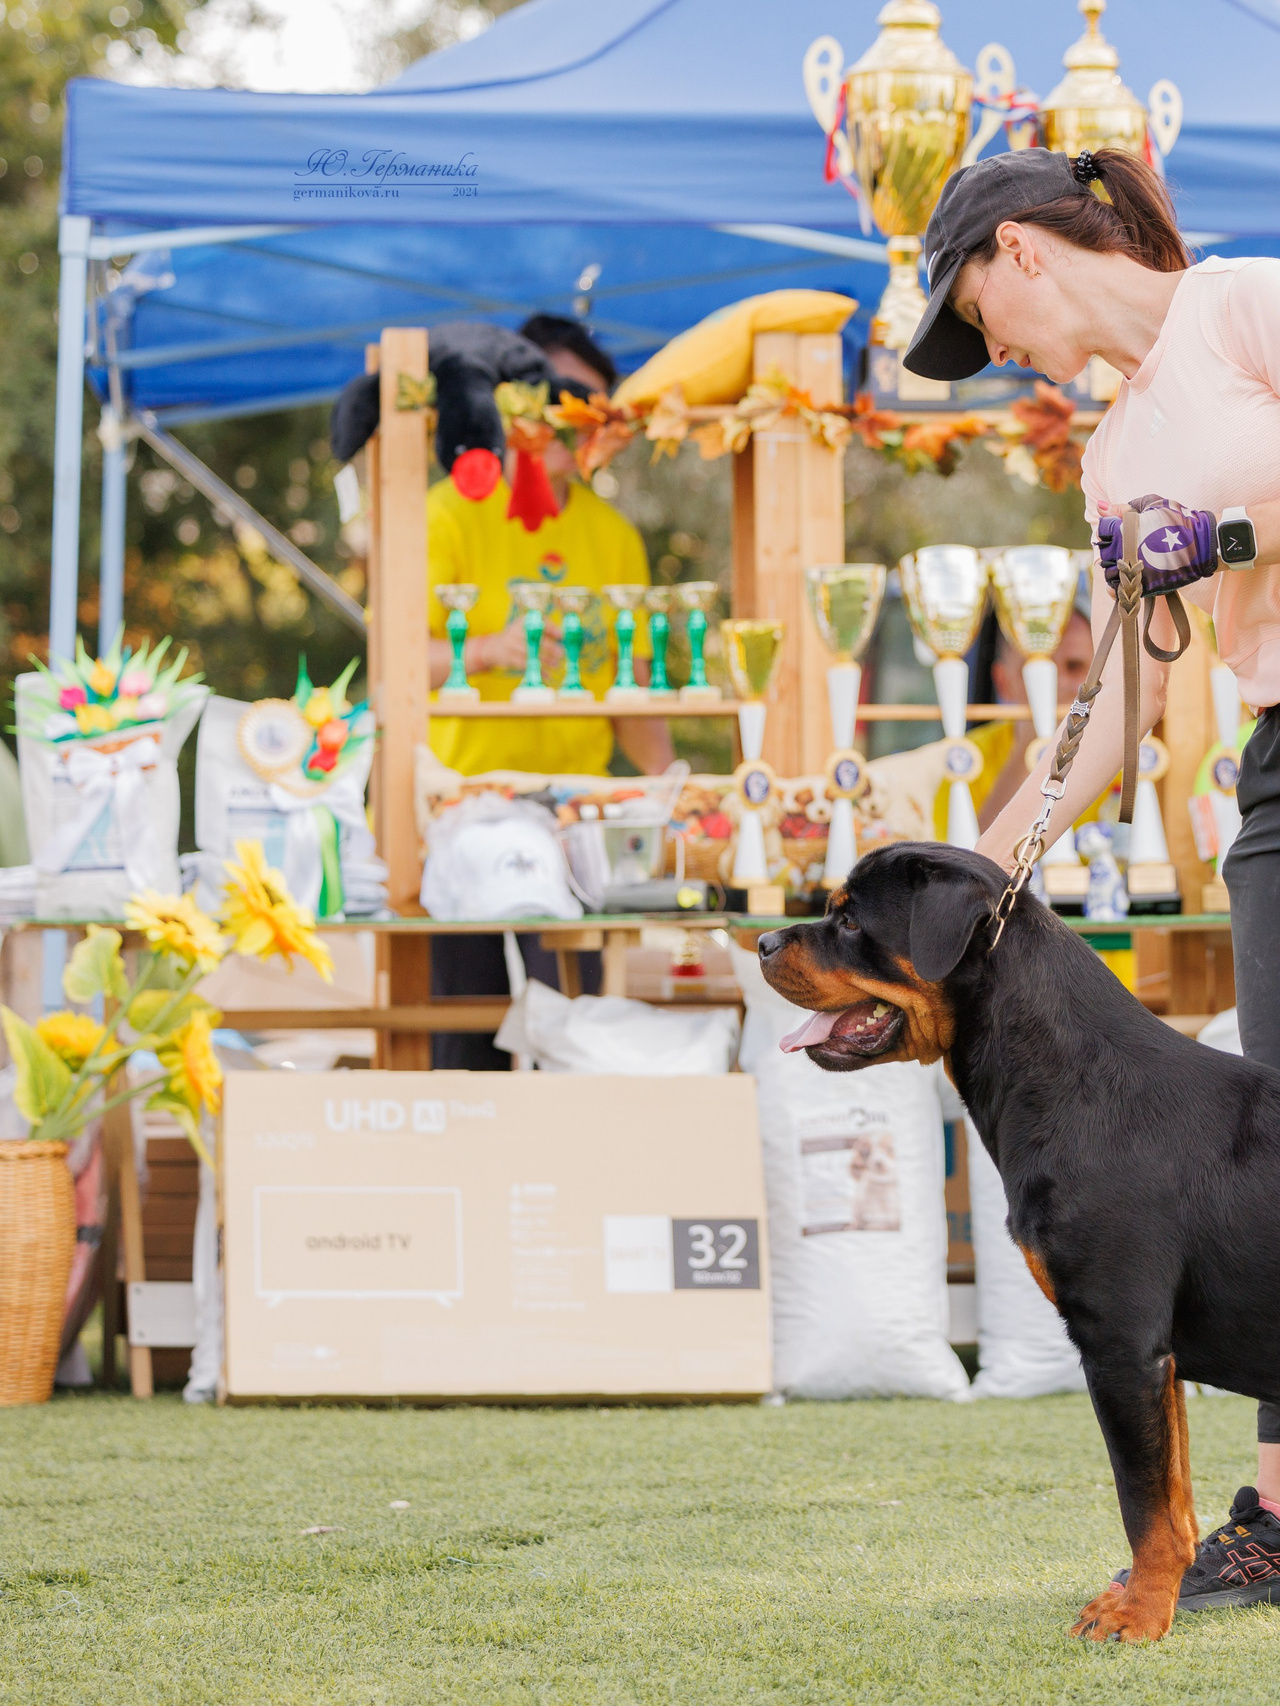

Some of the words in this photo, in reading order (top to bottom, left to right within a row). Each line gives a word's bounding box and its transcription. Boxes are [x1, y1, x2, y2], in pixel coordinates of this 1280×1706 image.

[324, 1099, 406, 1131] UHD
[305, 1231, 382, 1250] android
[386, 1232, 412, 1250] TV
[688, 1224, 748, 1269] 32
